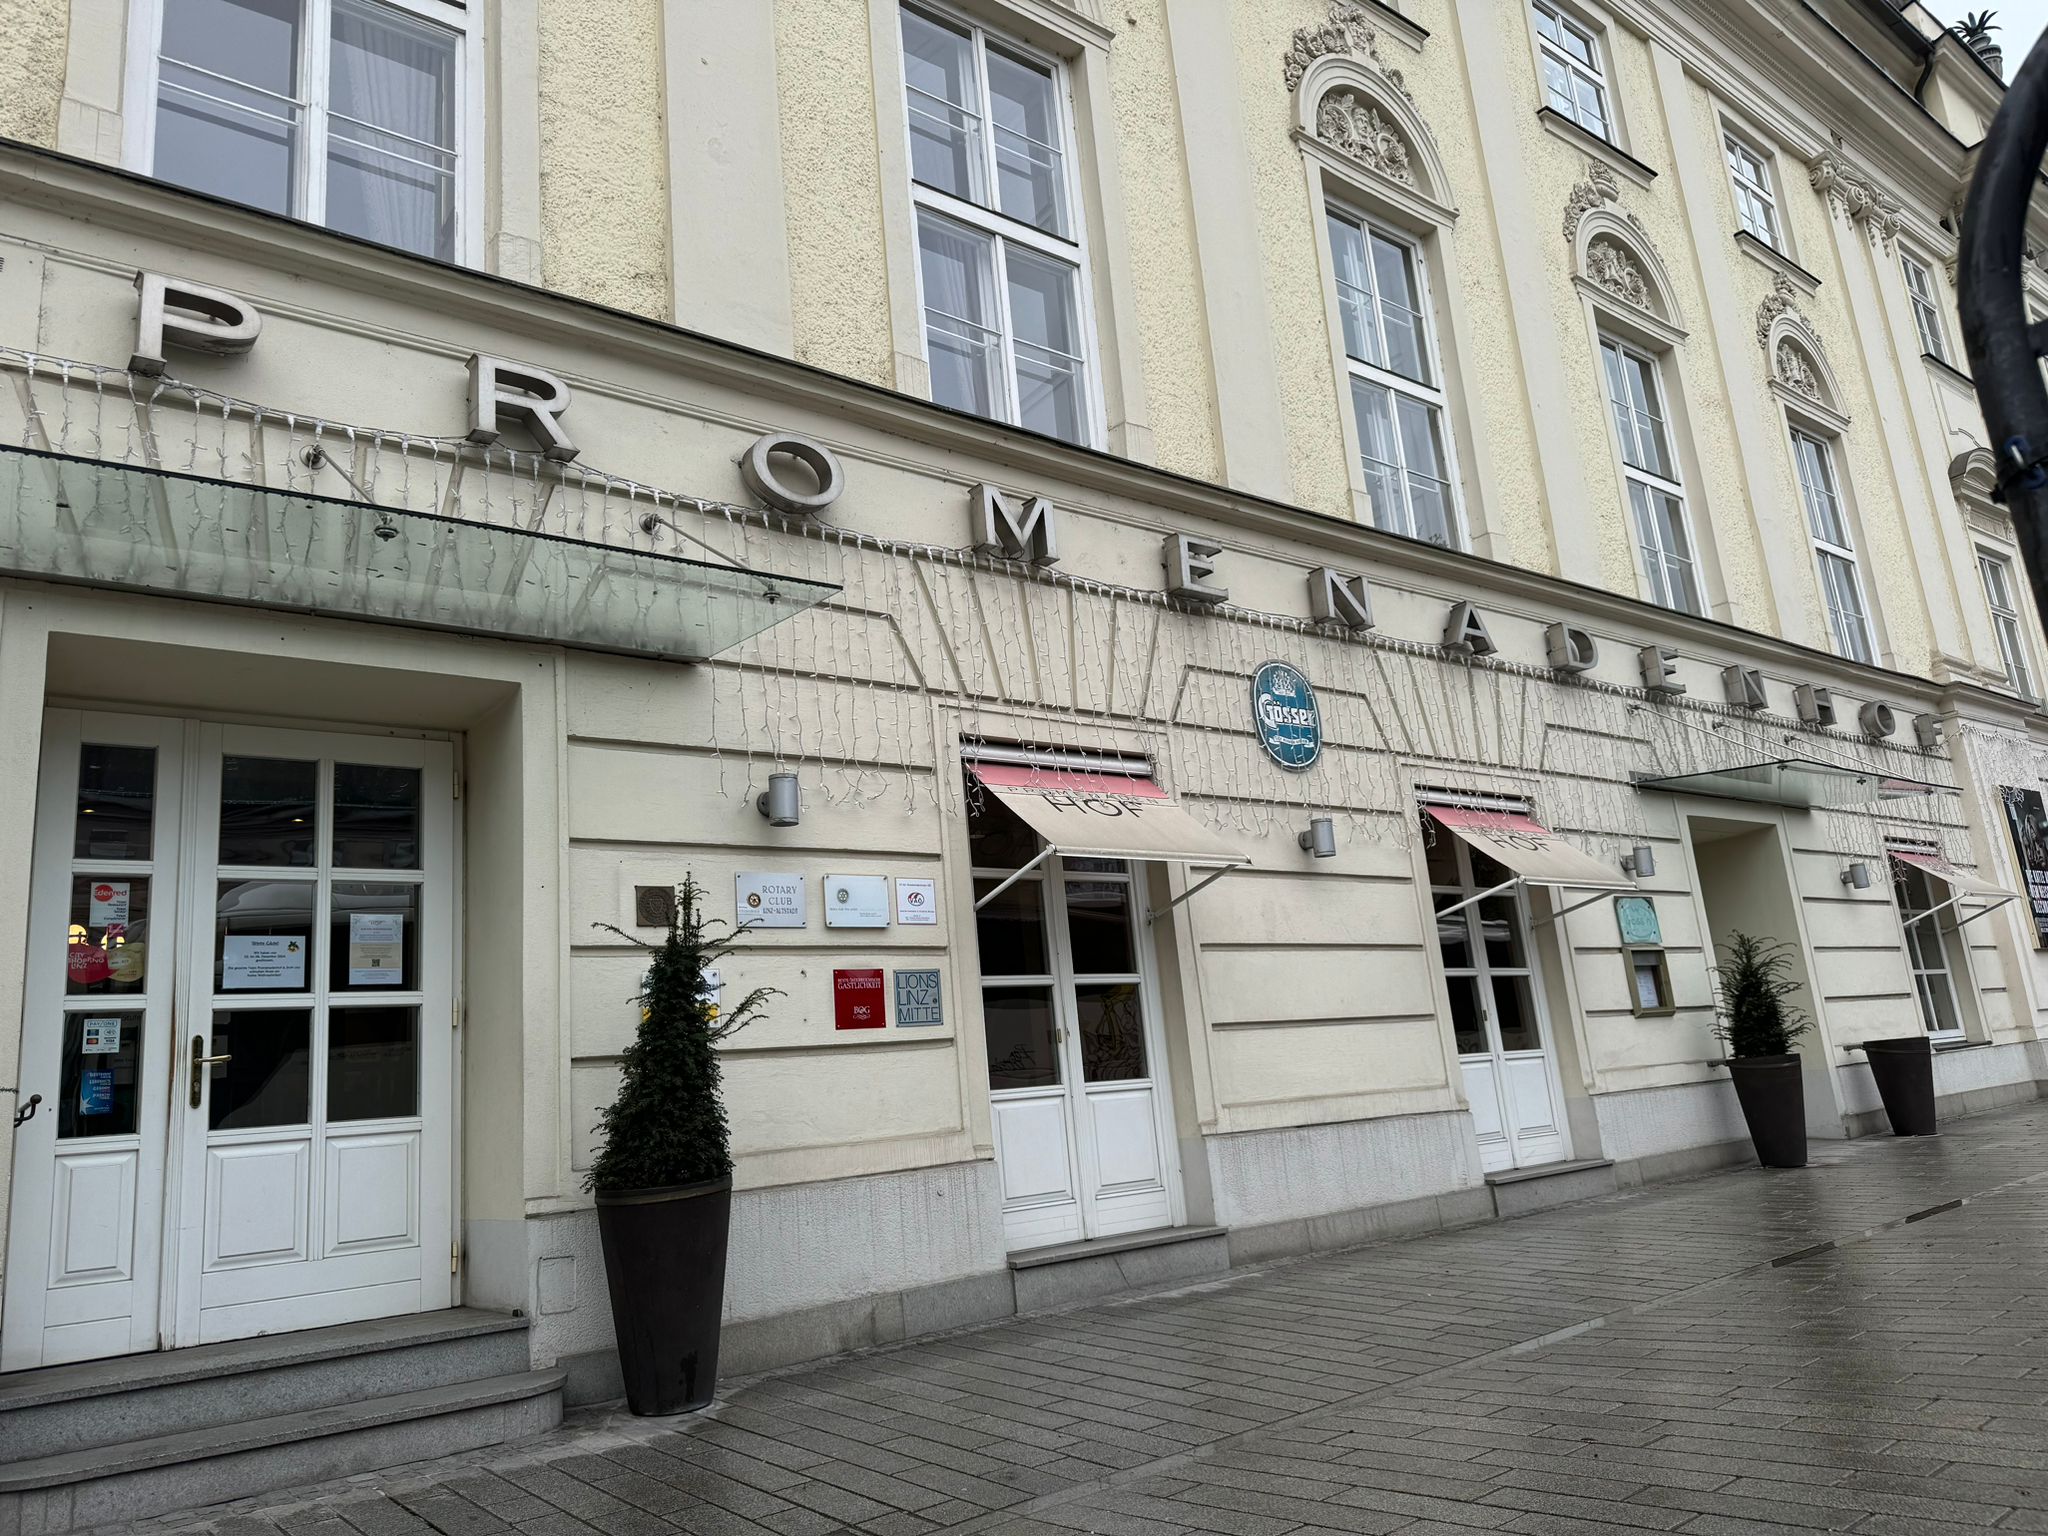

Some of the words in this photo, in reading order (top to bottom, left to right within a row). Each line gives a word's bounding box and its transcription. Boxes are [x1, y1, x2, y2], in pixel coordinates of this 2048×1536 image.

[1042, 794, 1144, 818] HOF
[1484, 833, 1552, 852] HOF
[762, 885, 798, 895] ROTARY
[768, 896, 793, 906] CLUB
[897, 974, 938, 990] LIONS
[898, 989, 930, 1006] LINZ
[899, 1006, 941, 1022] MITTE
